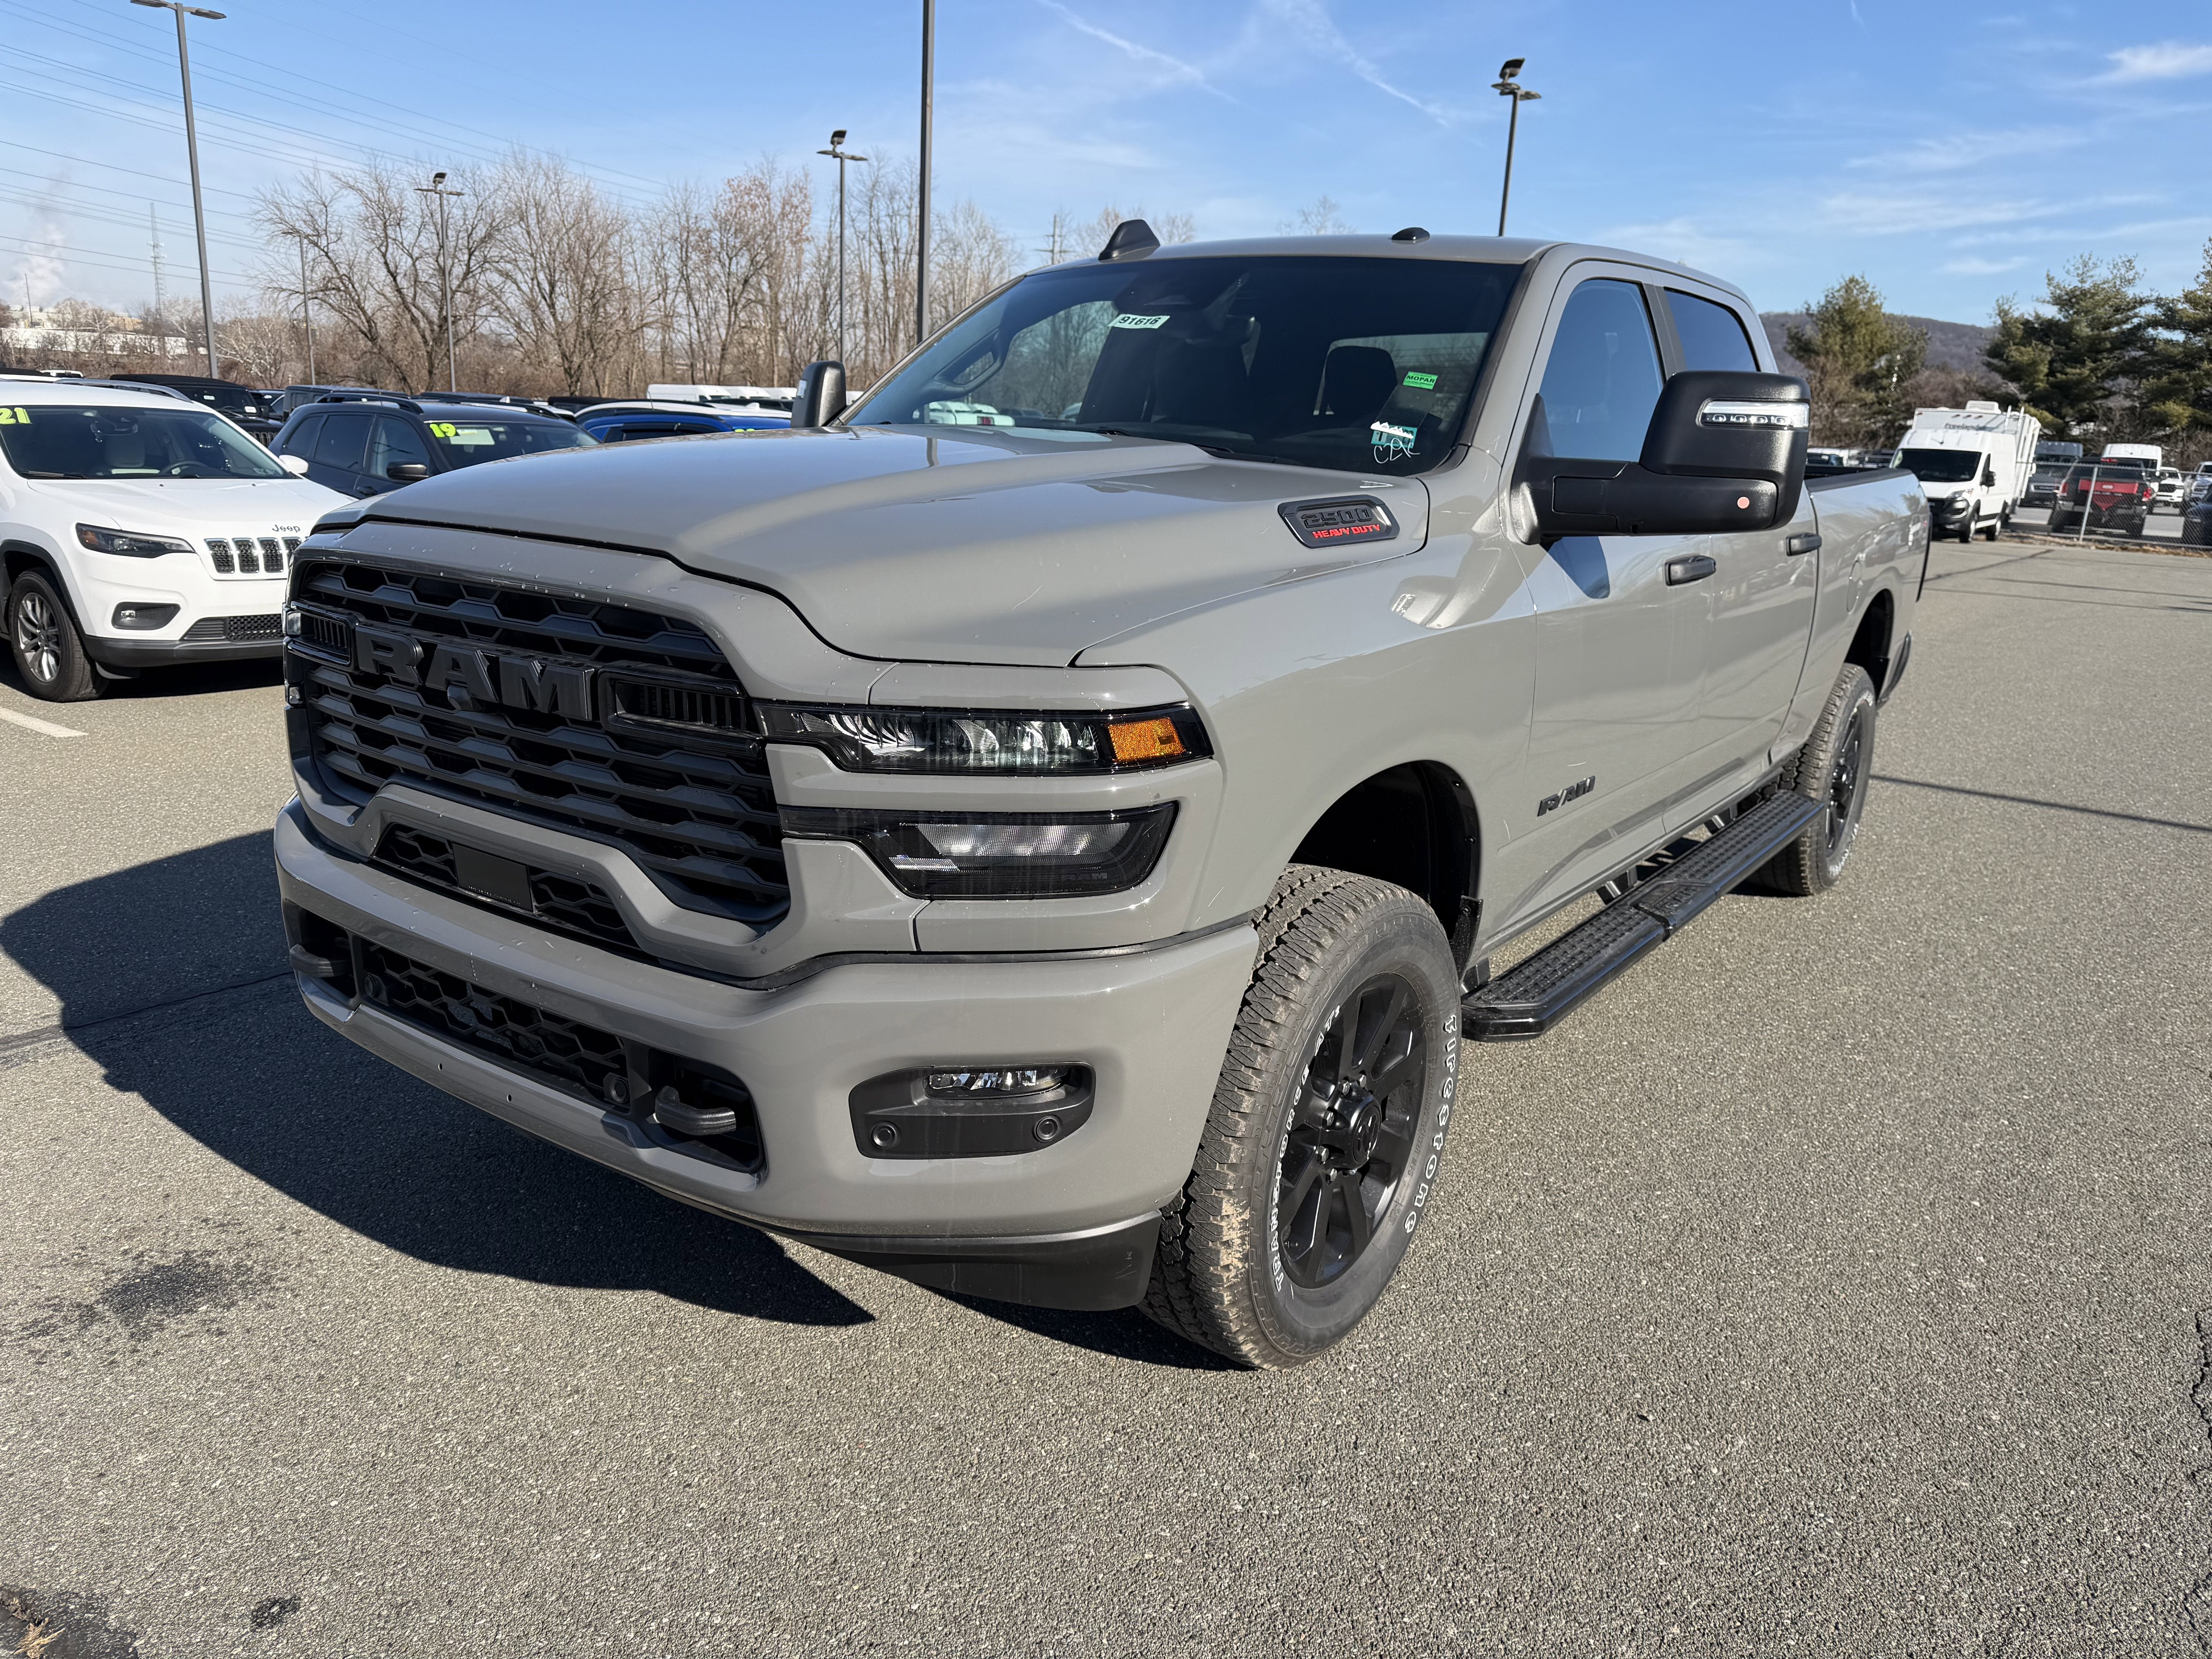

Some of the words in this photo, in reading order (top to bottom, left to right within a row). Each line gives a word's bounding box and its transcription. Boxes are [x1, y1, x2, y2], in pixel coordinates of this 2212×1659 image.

[1119, 316, 1161, 325] 91616
[430, 423, 456, 438] 19
[1301, 508, 1374, 529] 2500
[272, 524, 301, 533] Jeep
[1312, 527, 1350, 539] HEAVY
[1351, 524, 1381, 534] DUTY
[355, 624, 595, 722] RAM
[1537, 775, 1595, 817] RAM
[1405, 1015, 1457, 1233] Firestone
